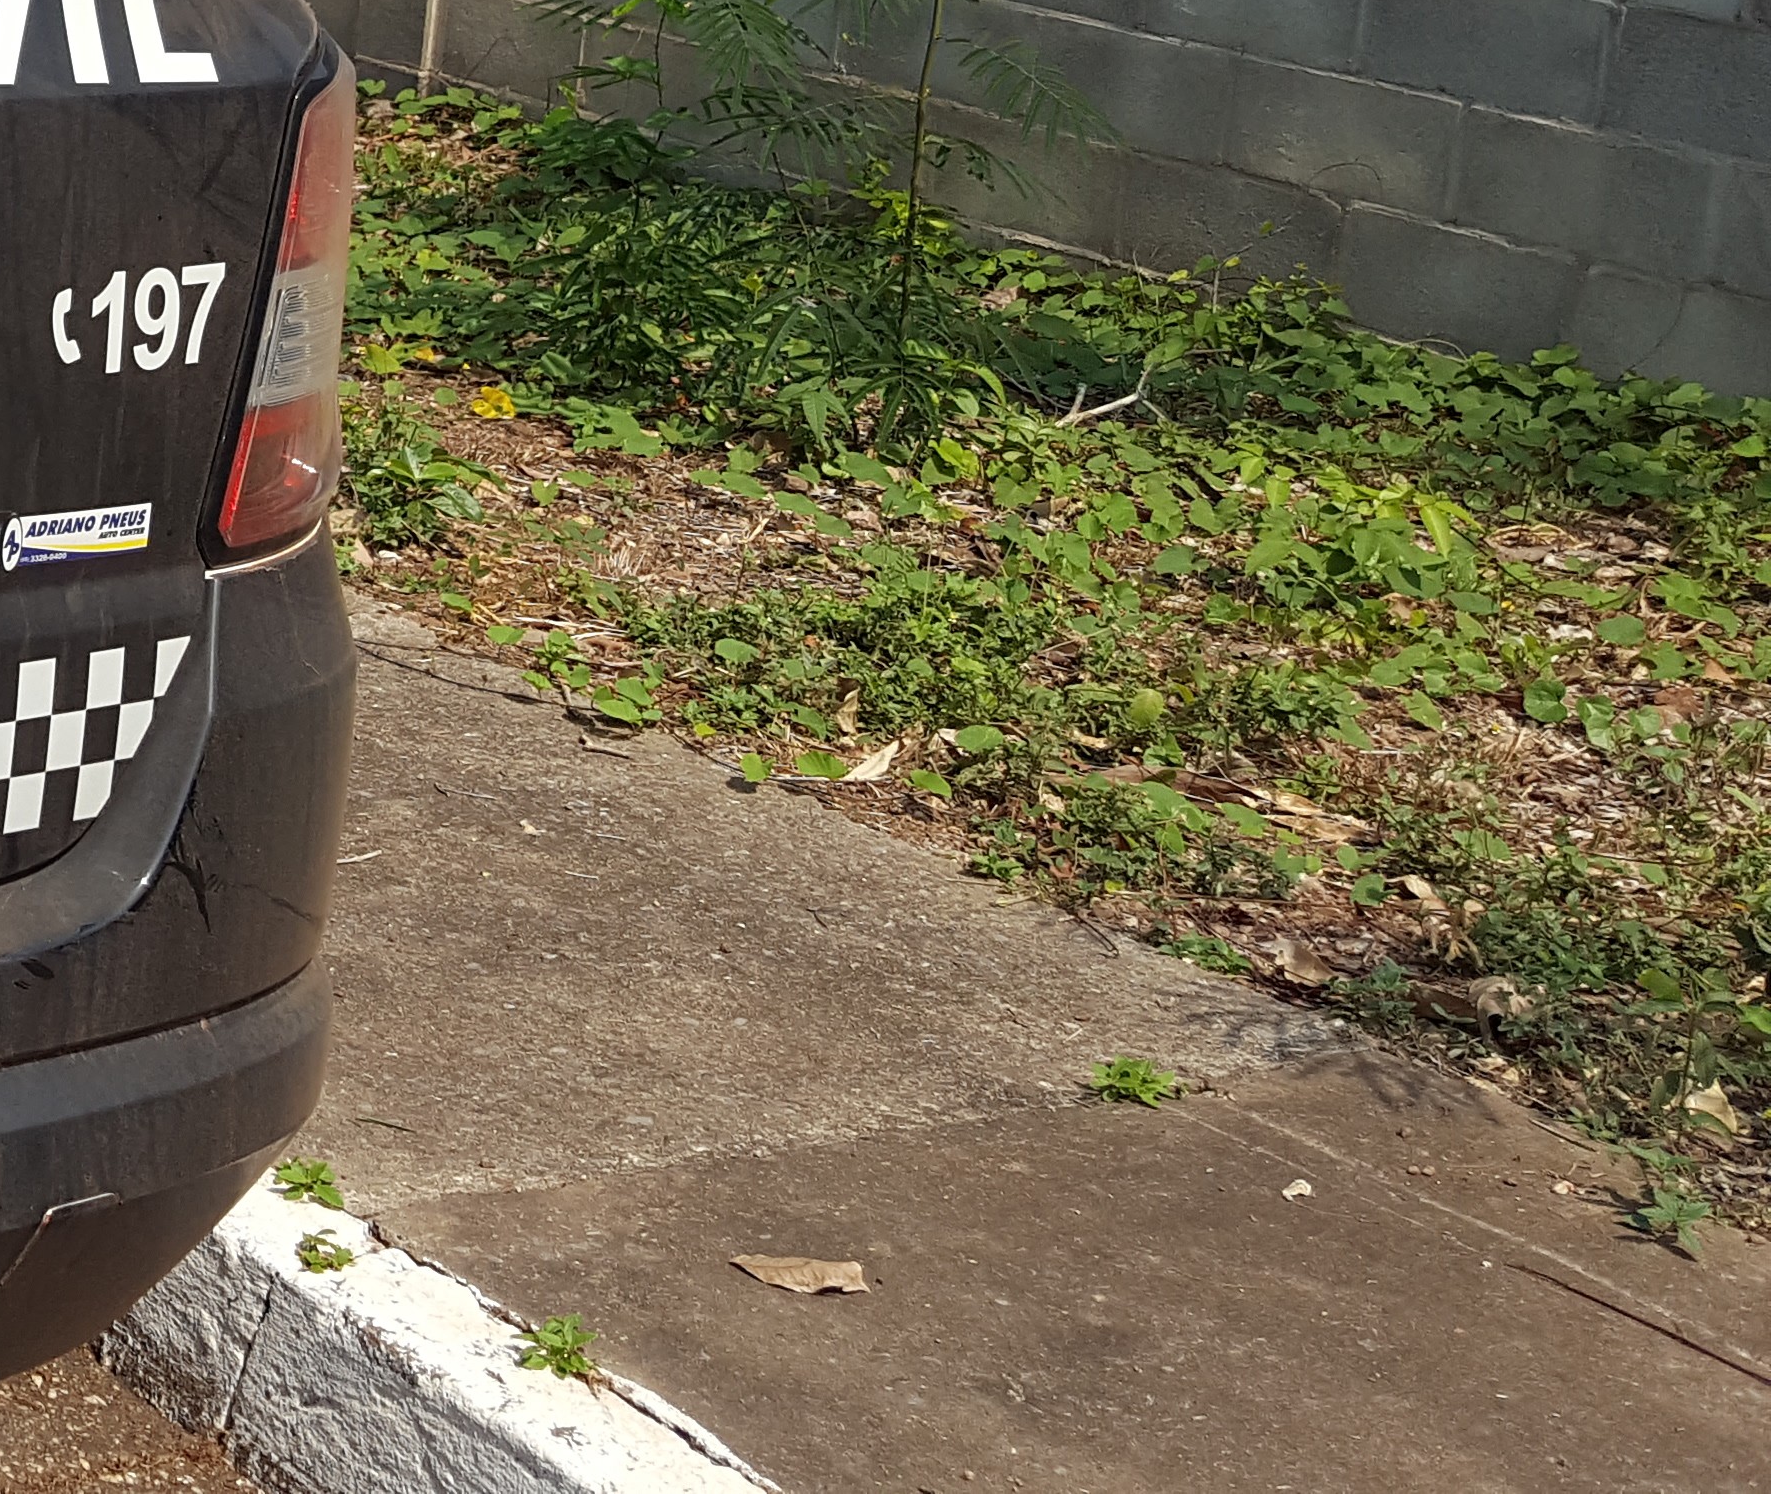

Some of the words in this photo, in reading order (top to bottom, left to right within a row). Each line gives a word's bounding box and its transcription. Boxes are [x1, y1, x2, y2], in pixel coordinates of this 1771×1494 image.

[90, 261, 227, 375] 197
[24, 515, 96, 539] ADRIANO
[99, 509, 147, 531] PNEUS
